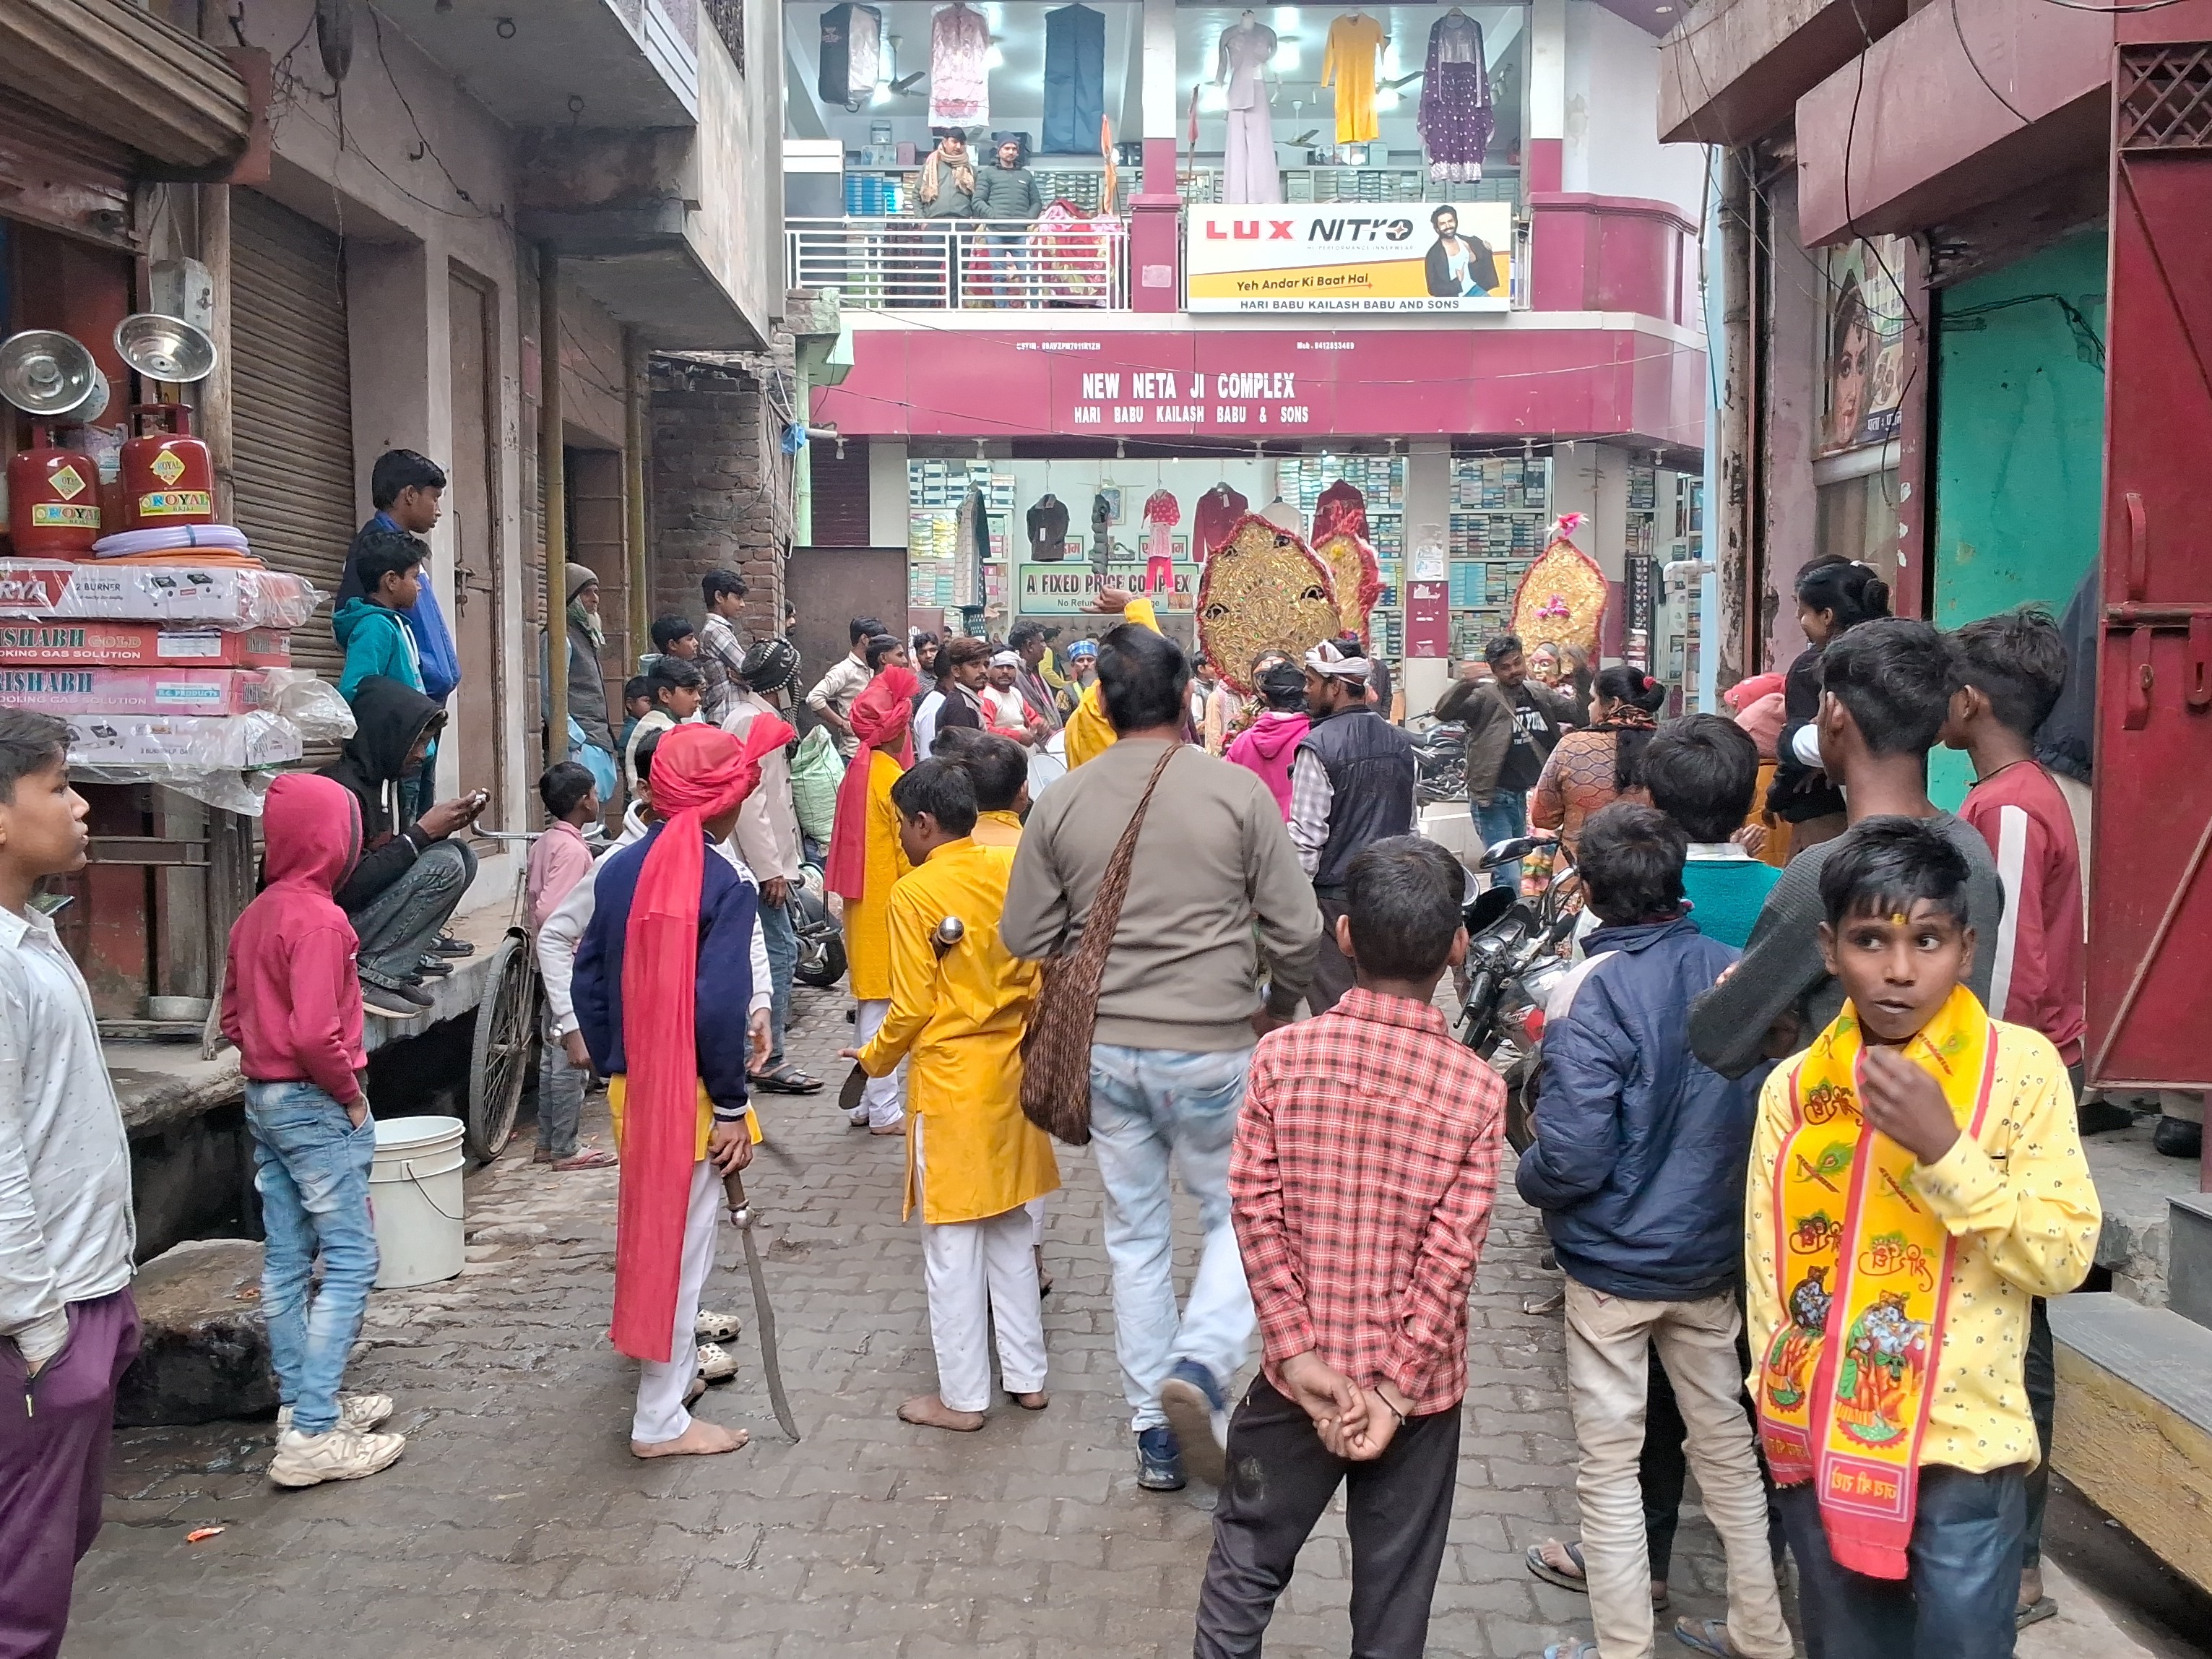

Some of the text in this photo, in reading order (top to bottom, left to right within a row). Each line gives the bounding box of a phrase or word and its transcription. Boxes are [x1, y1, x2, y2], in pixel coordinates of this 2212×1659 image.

[1206, 220, 1296, 240] LUX
[1237, 280, 1258, 291] Yeh
[1261, 277, 1300, 290] Andar
[1302, 276, 1314, 287] Ki
[1317, 275, 1345, 286] Baat
[1240, 300, 1459, 309] HARI BABU KAILASH BABU AND SONS
[1082, 372, 1295, 399] NEW NETA JI COMPLEX
[1074, 405, 1308, 423] HARI BABU KAILASH BABU & SONS
[152, 494, 209, 507] ROYAL
[84, 582, 121, 591] BURNER
[1027, 574, 1037, 595] A
[1042, 574, 1081, 595] FIXED
[1128, 574, 1192, 595] COPEX
[88, 635, 142, 648] GOLD
